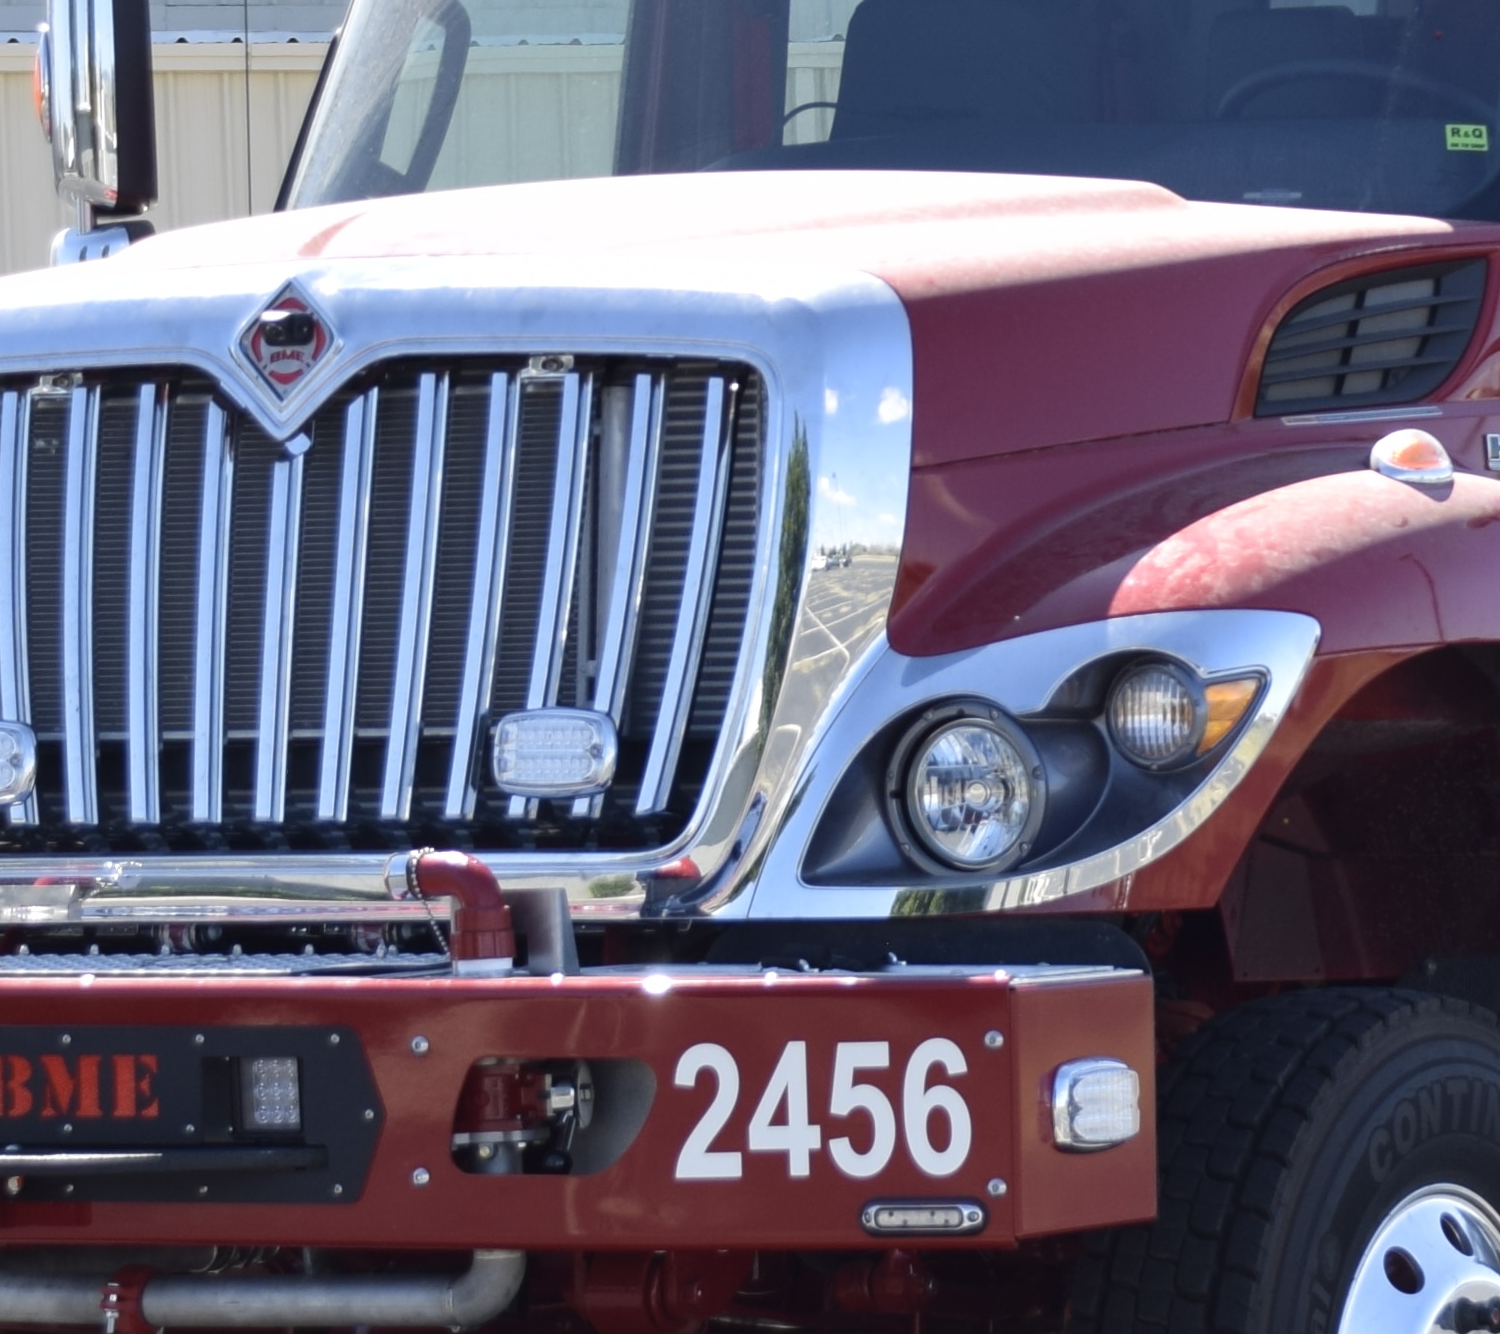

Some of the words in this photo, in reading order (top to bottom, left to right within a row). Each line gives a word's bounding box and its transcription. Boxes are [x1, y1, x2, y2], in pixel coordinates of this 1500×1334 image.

[1451, 127, 1461, 138] R
[1472, 128, 1483, 139] Q
[270, 349, 305, 363] BME
[673, 1038, 973, 1181] 2456
